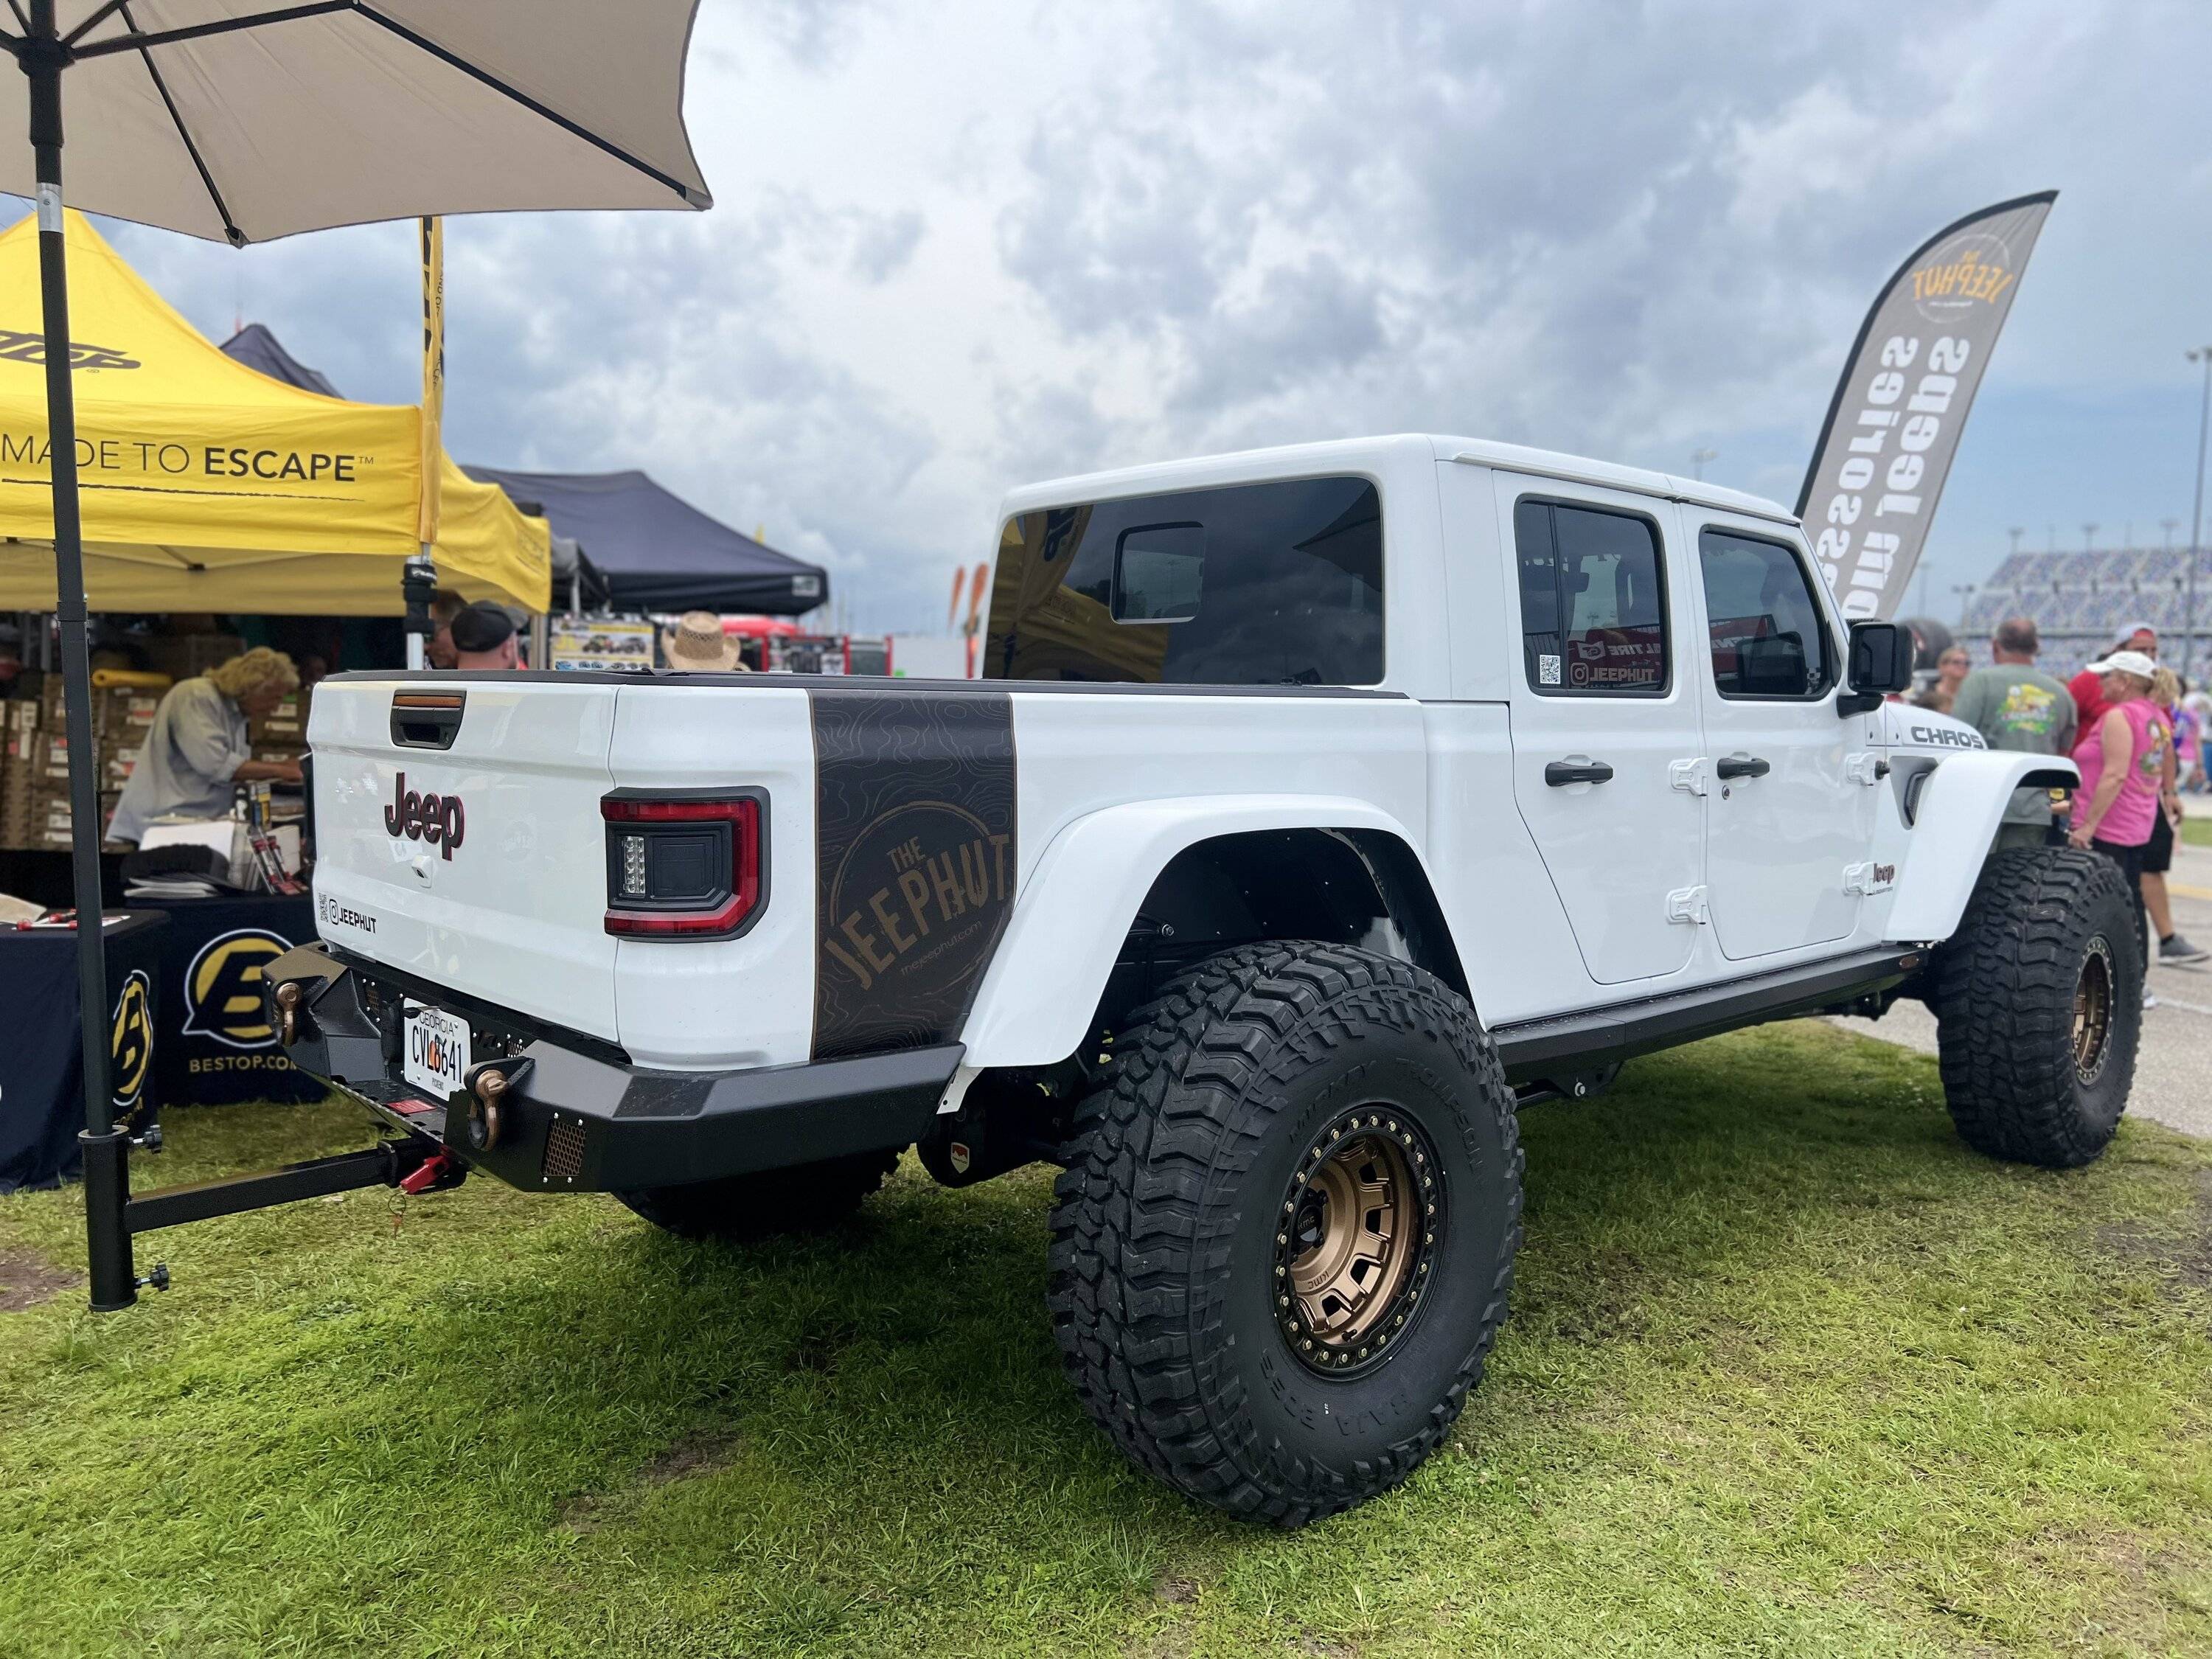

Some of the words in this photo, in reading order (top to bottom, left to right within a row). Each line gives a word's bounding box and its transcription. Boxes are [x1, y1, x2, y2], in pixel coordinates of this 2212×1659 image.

[133, 442, 189, 473] TO
[1589, 667, 1655, 682] JEEPHUT
[1910, 726, 1984, 749] CHAOS
[384, 772, 465, 861] Jeep
[887, 836, 926, 873] THE
[339, 907, 377, 934] JEEPHUT
[824, 833, 1010, 991] JEEPHUT
[419, 1011, 454, 1037] GEORGIA
[413, 1025, 462, 1083] CVL8641
